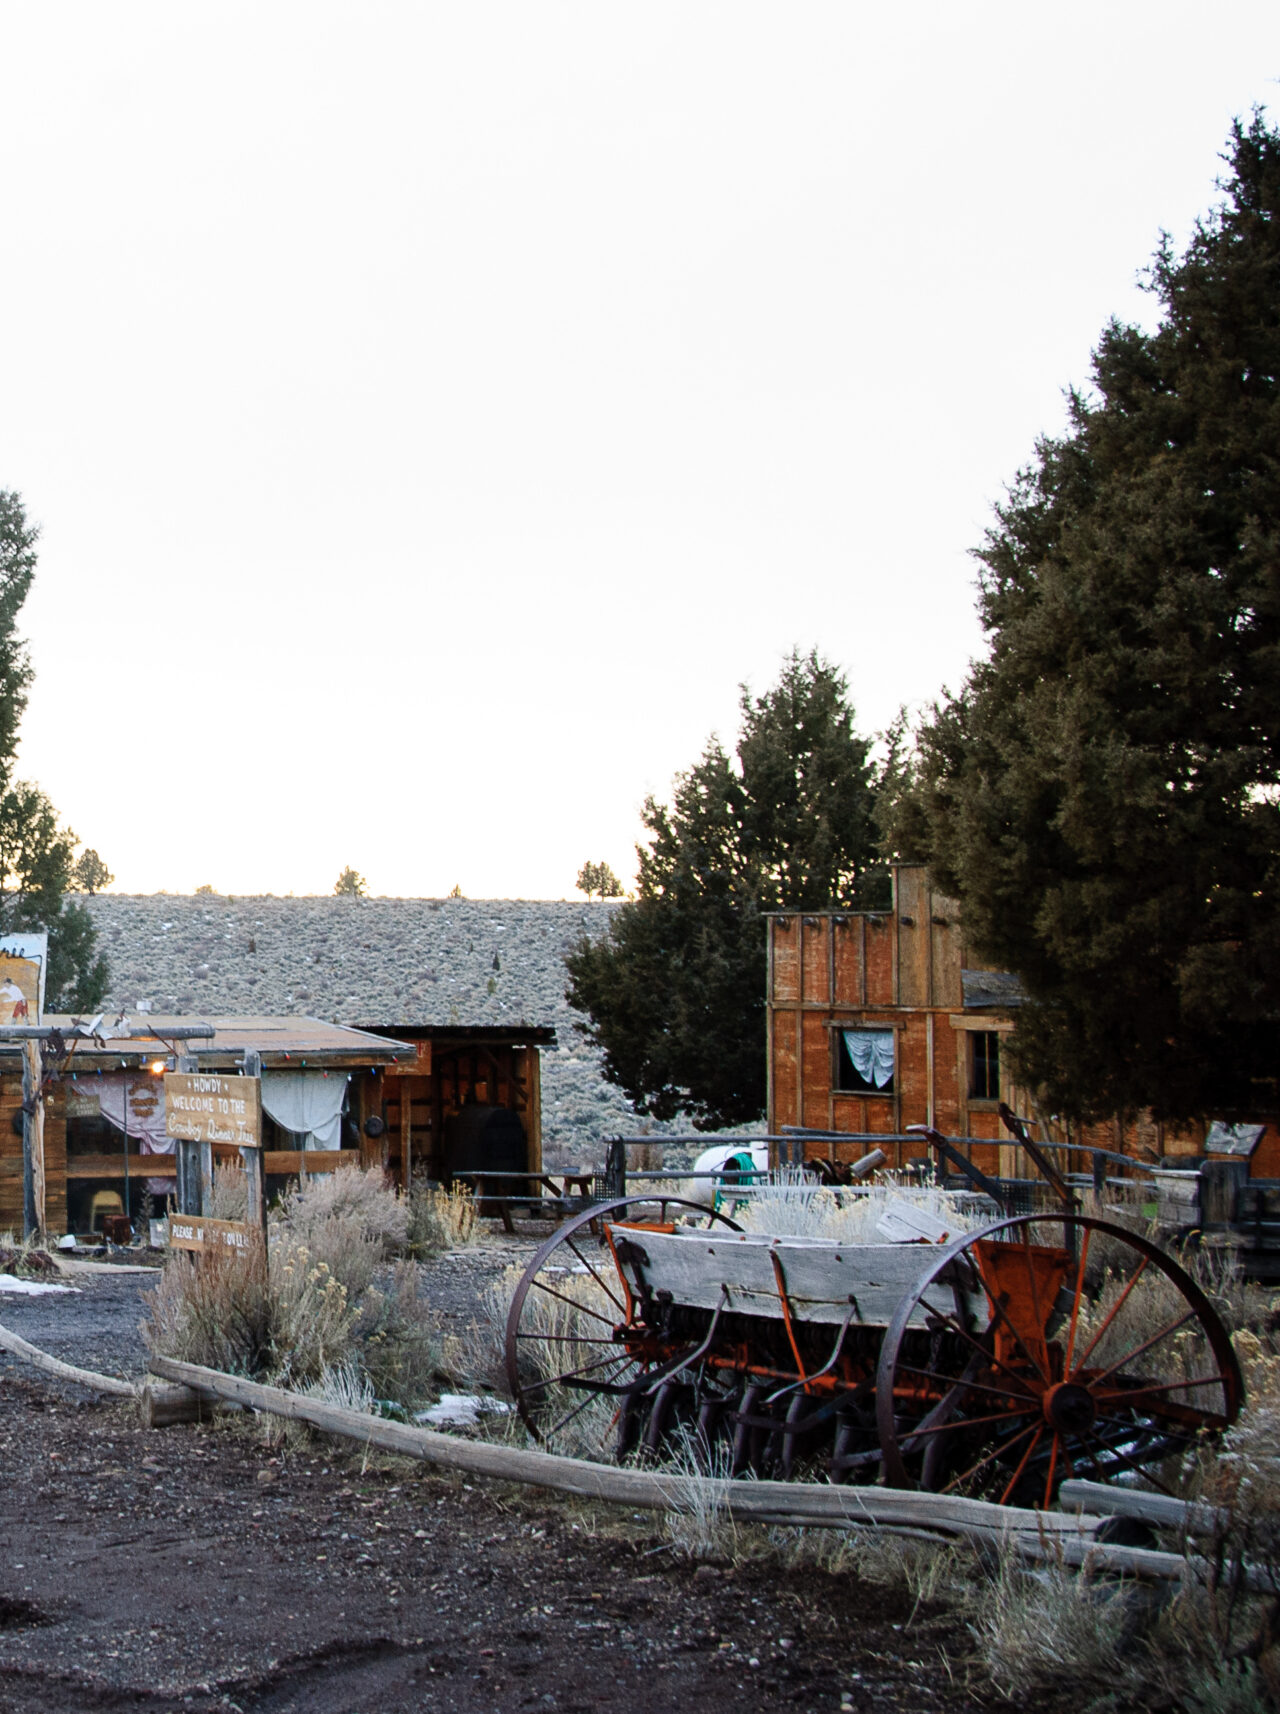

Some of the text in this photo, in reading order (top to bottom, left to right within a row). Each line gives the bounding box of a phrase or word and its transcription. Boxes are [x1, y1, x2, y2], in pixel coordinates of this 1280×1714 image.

[193, 1078, 222, 1093] HOWDY
[172, 1095, 245, 1114] WELCOME TO THE
[168, 1112, 256, 1145] Cowboy Dinner Tree
[172, 1224, 194, 1240] PLEASE
